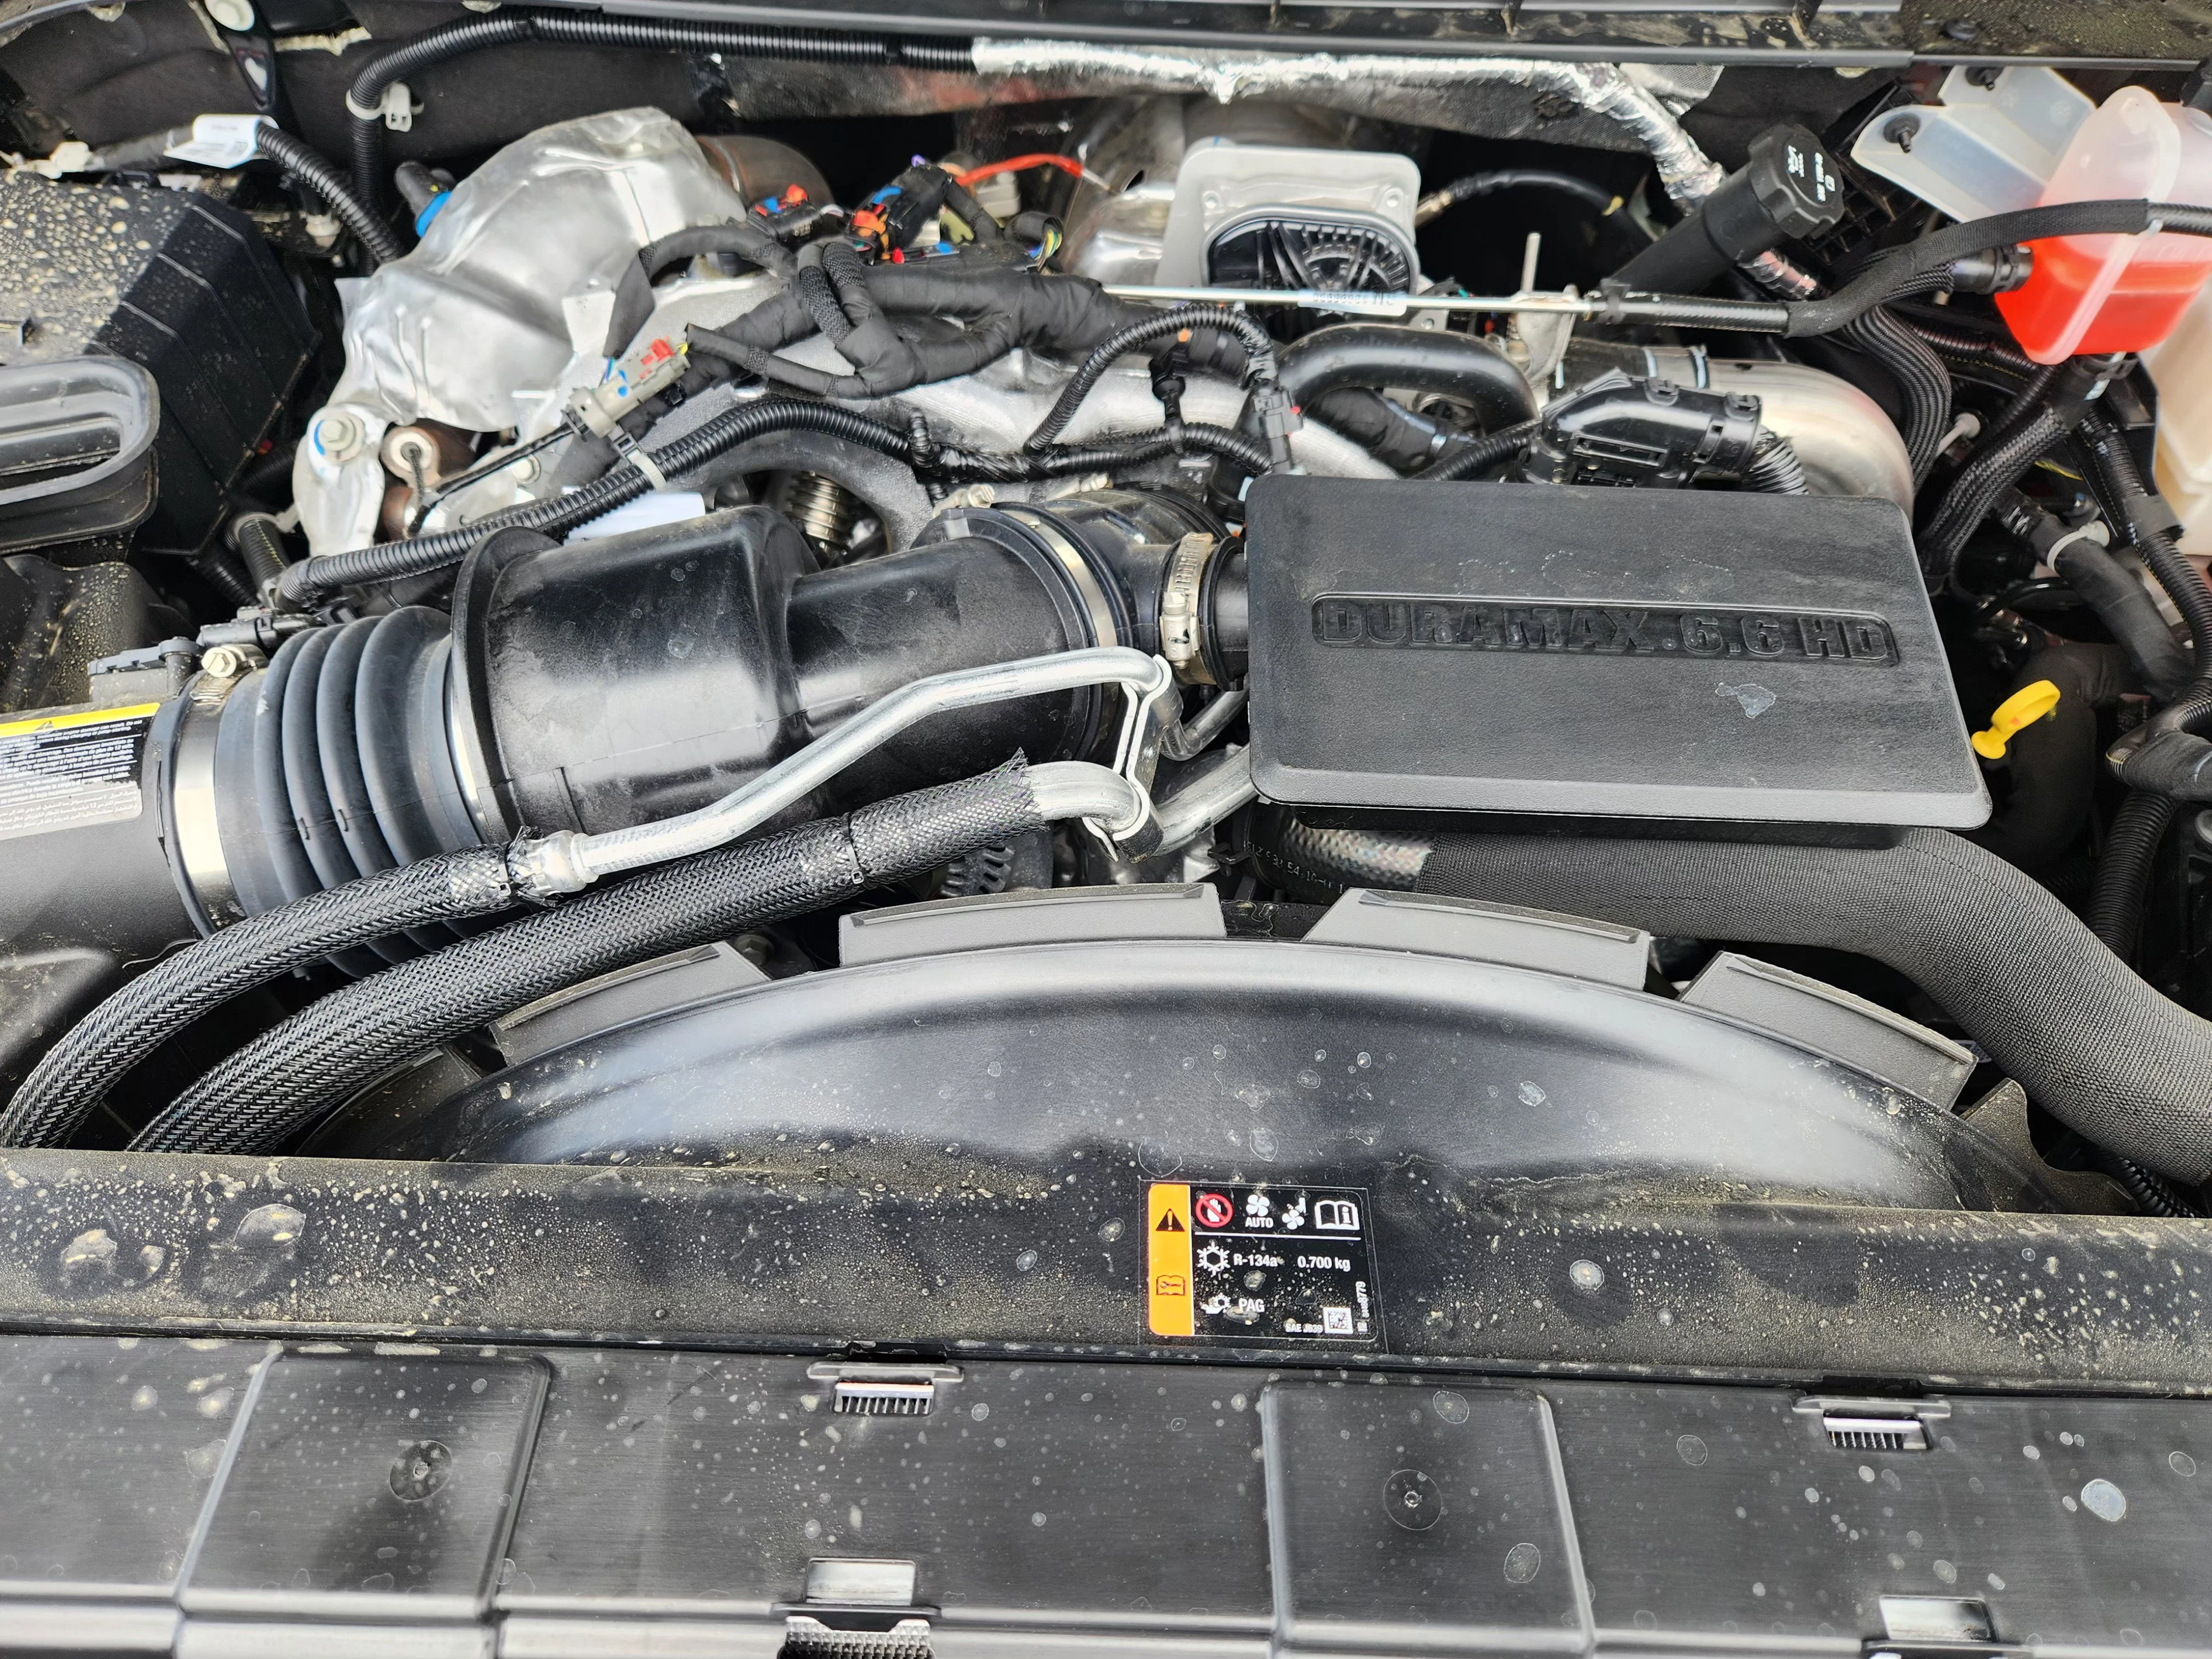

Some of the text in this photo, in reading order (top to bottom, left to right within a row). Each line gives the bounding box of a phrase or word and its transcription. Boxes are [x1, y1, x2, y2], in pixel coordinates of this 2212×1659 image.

[1323, 601, 1888, 660] DURAMAX 6.6 HD
[1245, 1217, 1274, 1228] AUTO
[1233, 1253, 1351, 1272] R-134a 0.700 kg
[1238, 1298, 1265, 1313] PAG
[1285, 1323, 1323, 1333] SAE J639
